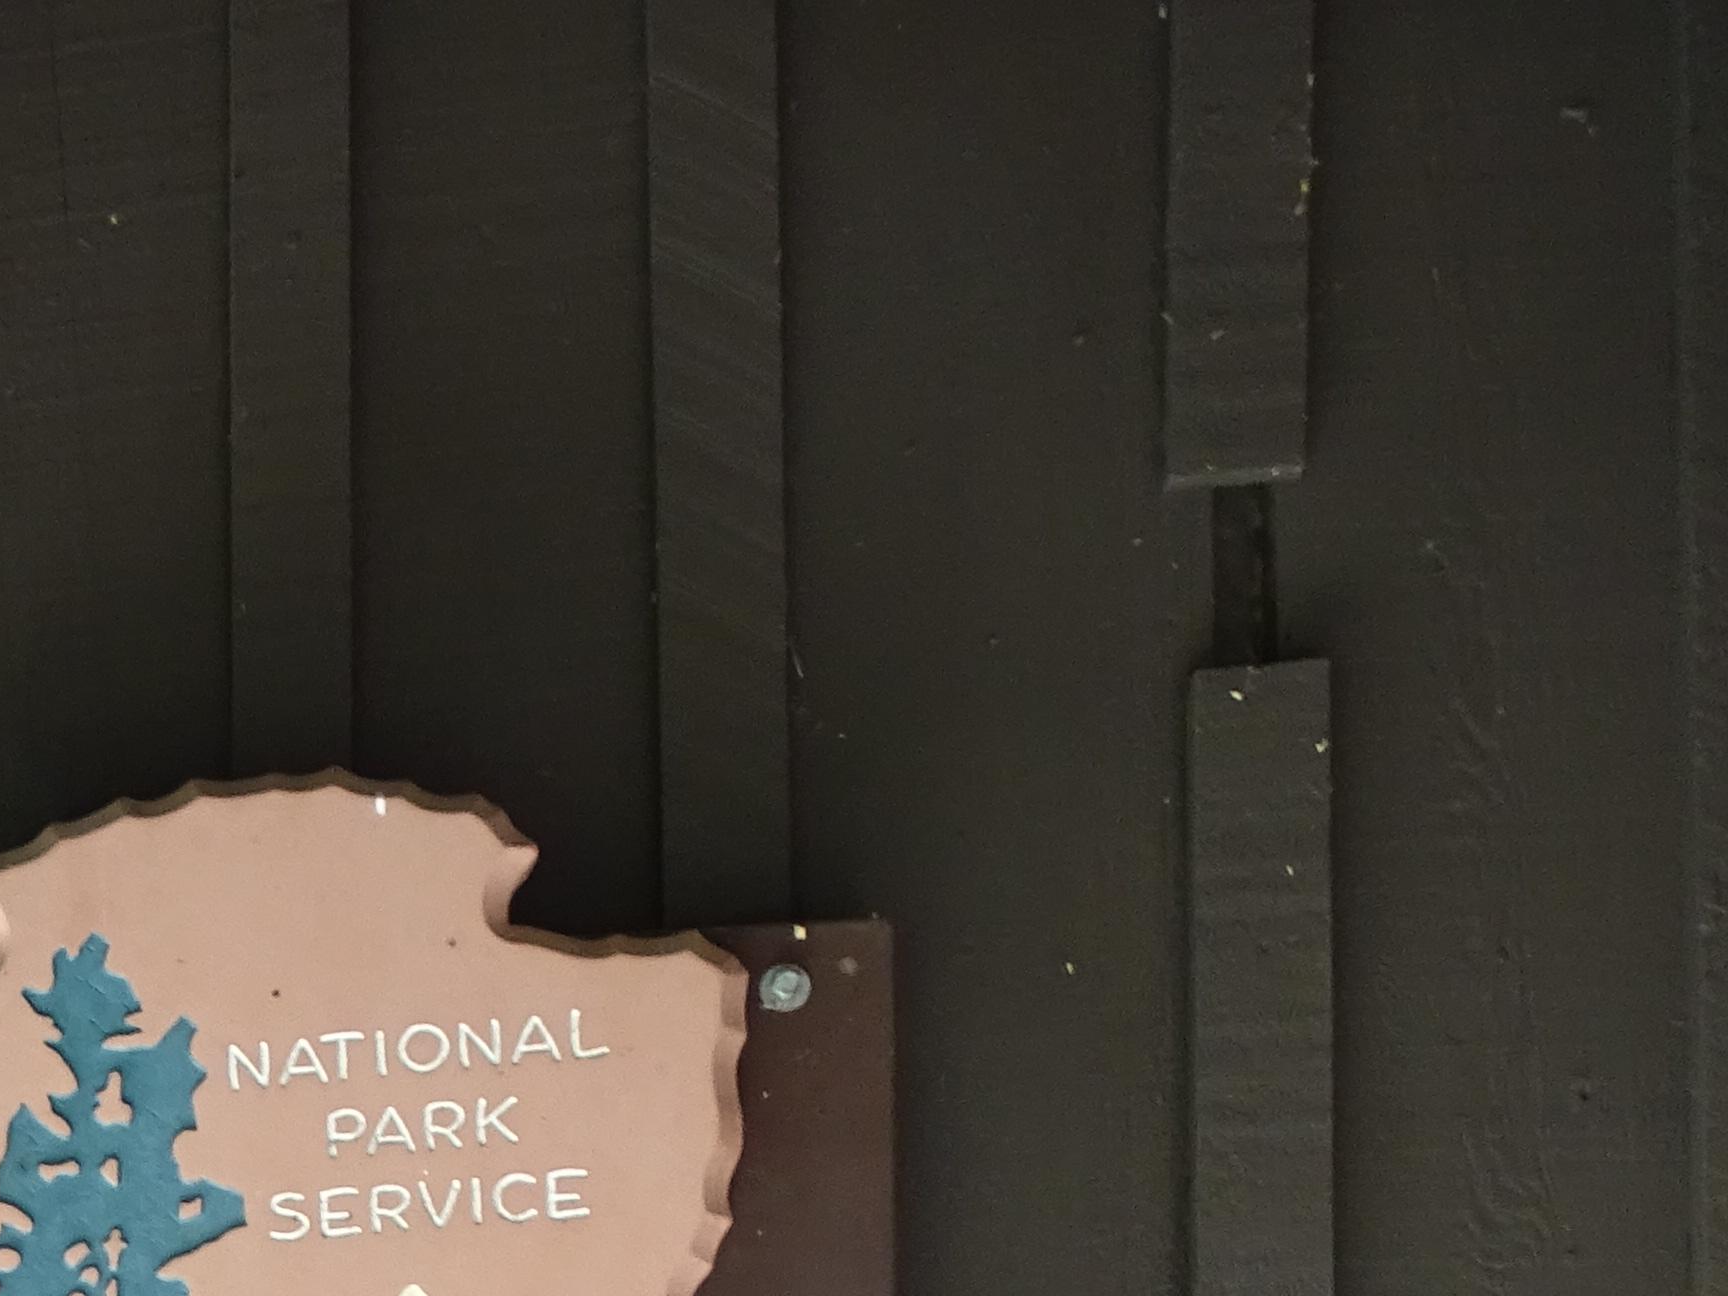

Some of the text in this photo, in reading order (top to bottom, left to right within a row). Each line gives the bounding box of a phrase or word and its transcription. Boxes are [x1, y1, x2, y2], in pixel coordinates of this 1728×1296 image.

[227, 1007, 611, 1091] NATIONAL
[325, 1095, 520, 1156] PARK
[268, 1167, 591, 1241] SERVICE
